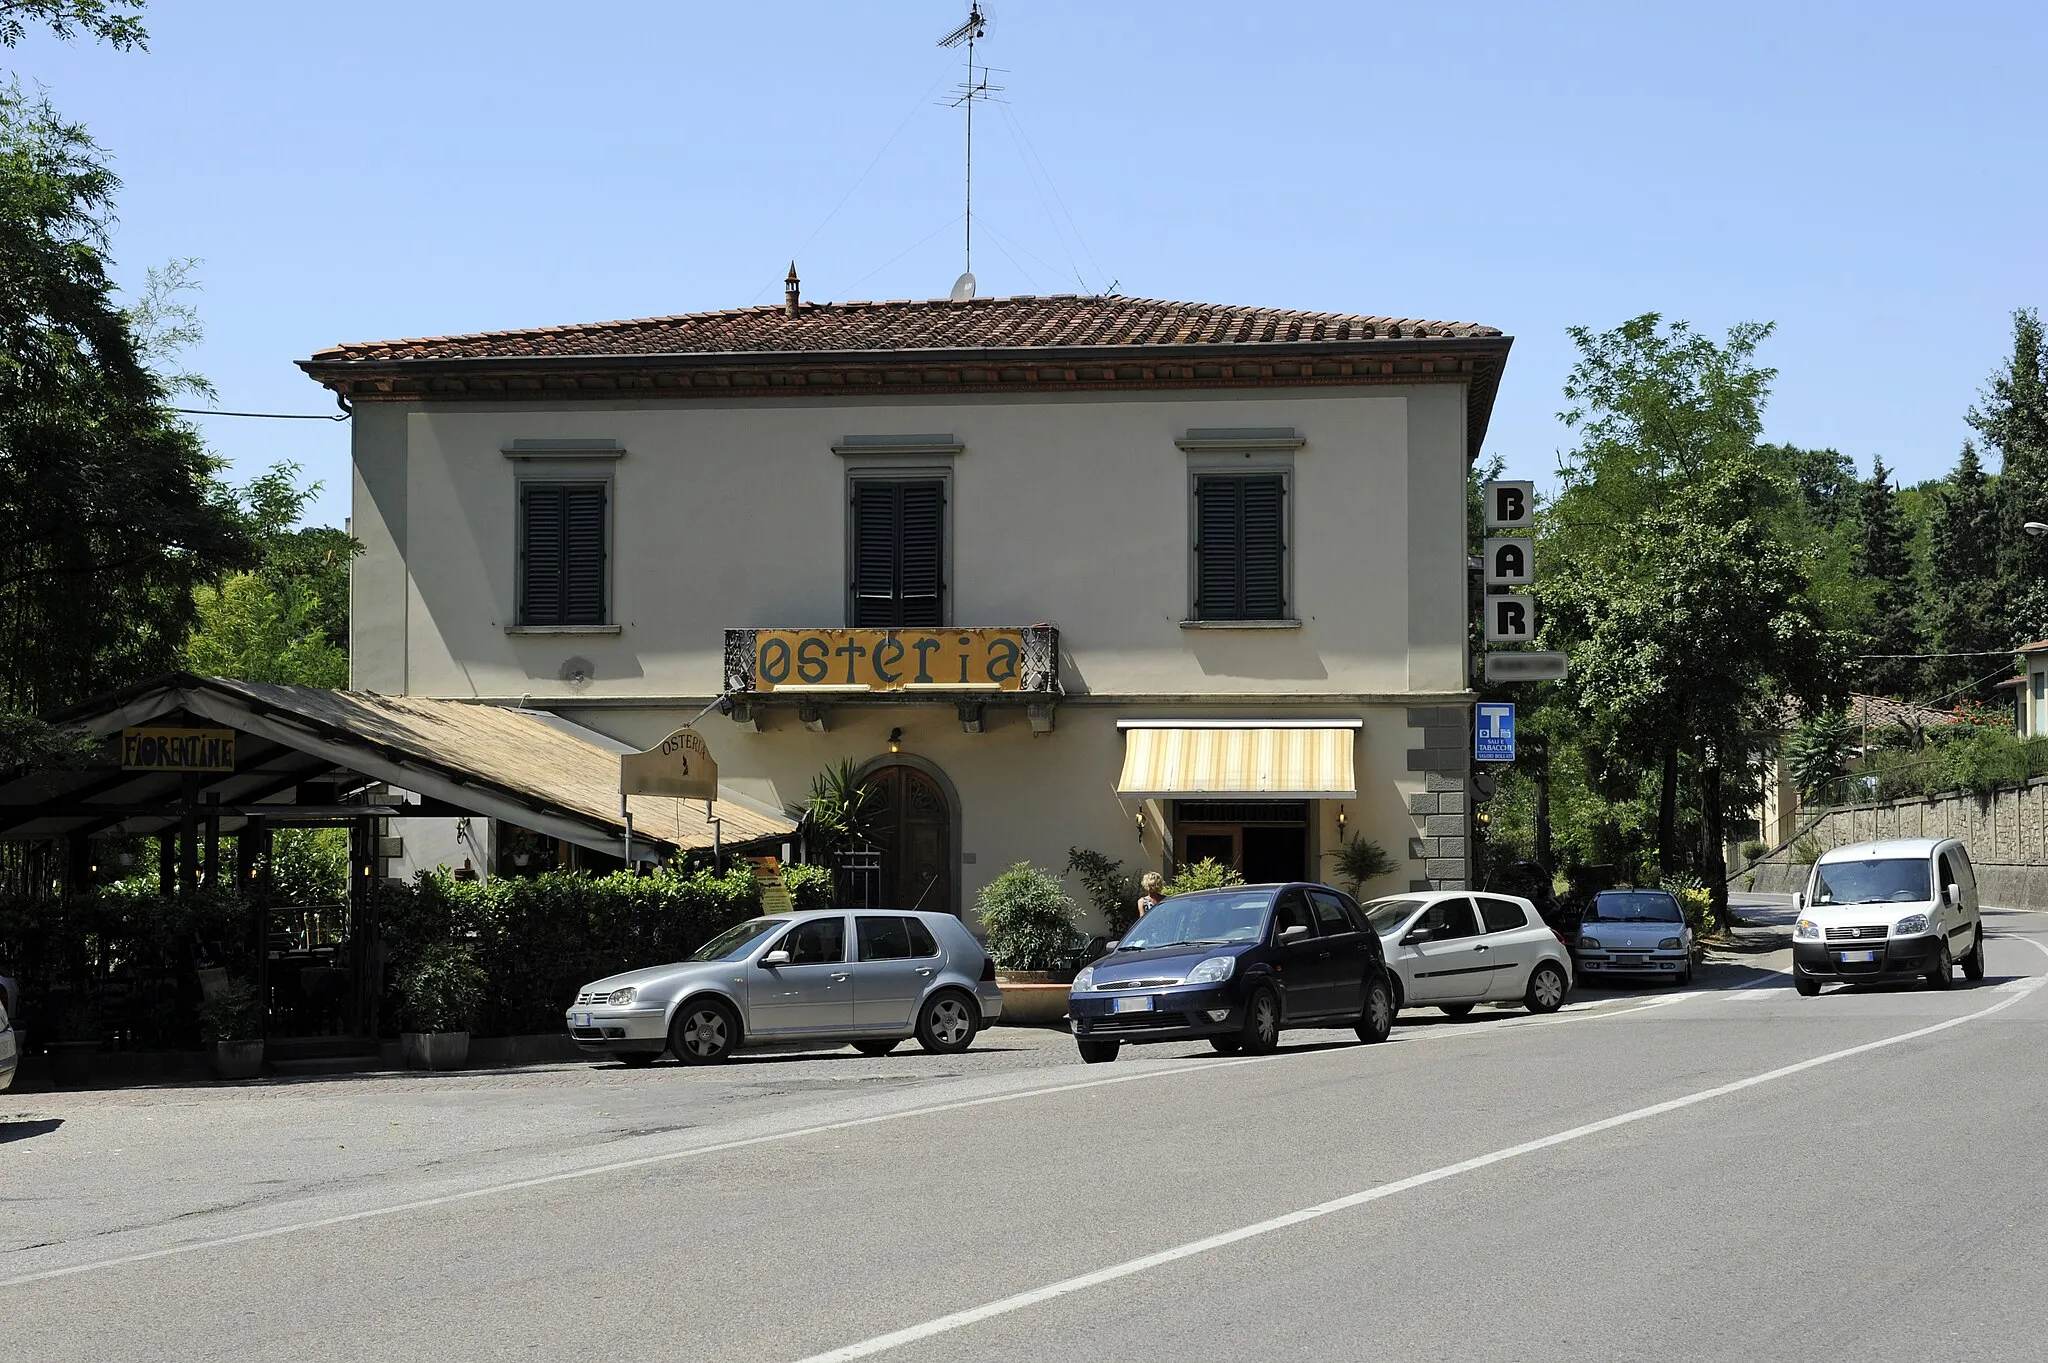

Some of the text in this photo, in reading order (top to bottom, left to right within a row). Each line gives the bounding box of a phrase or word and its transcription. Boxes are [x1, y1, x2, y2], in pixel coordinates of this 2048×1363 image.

[1495, 487, 1526, 635] BAR
[1481, 707, 1509, 738] T
[662, 734, 706, 760] OSTERIA
